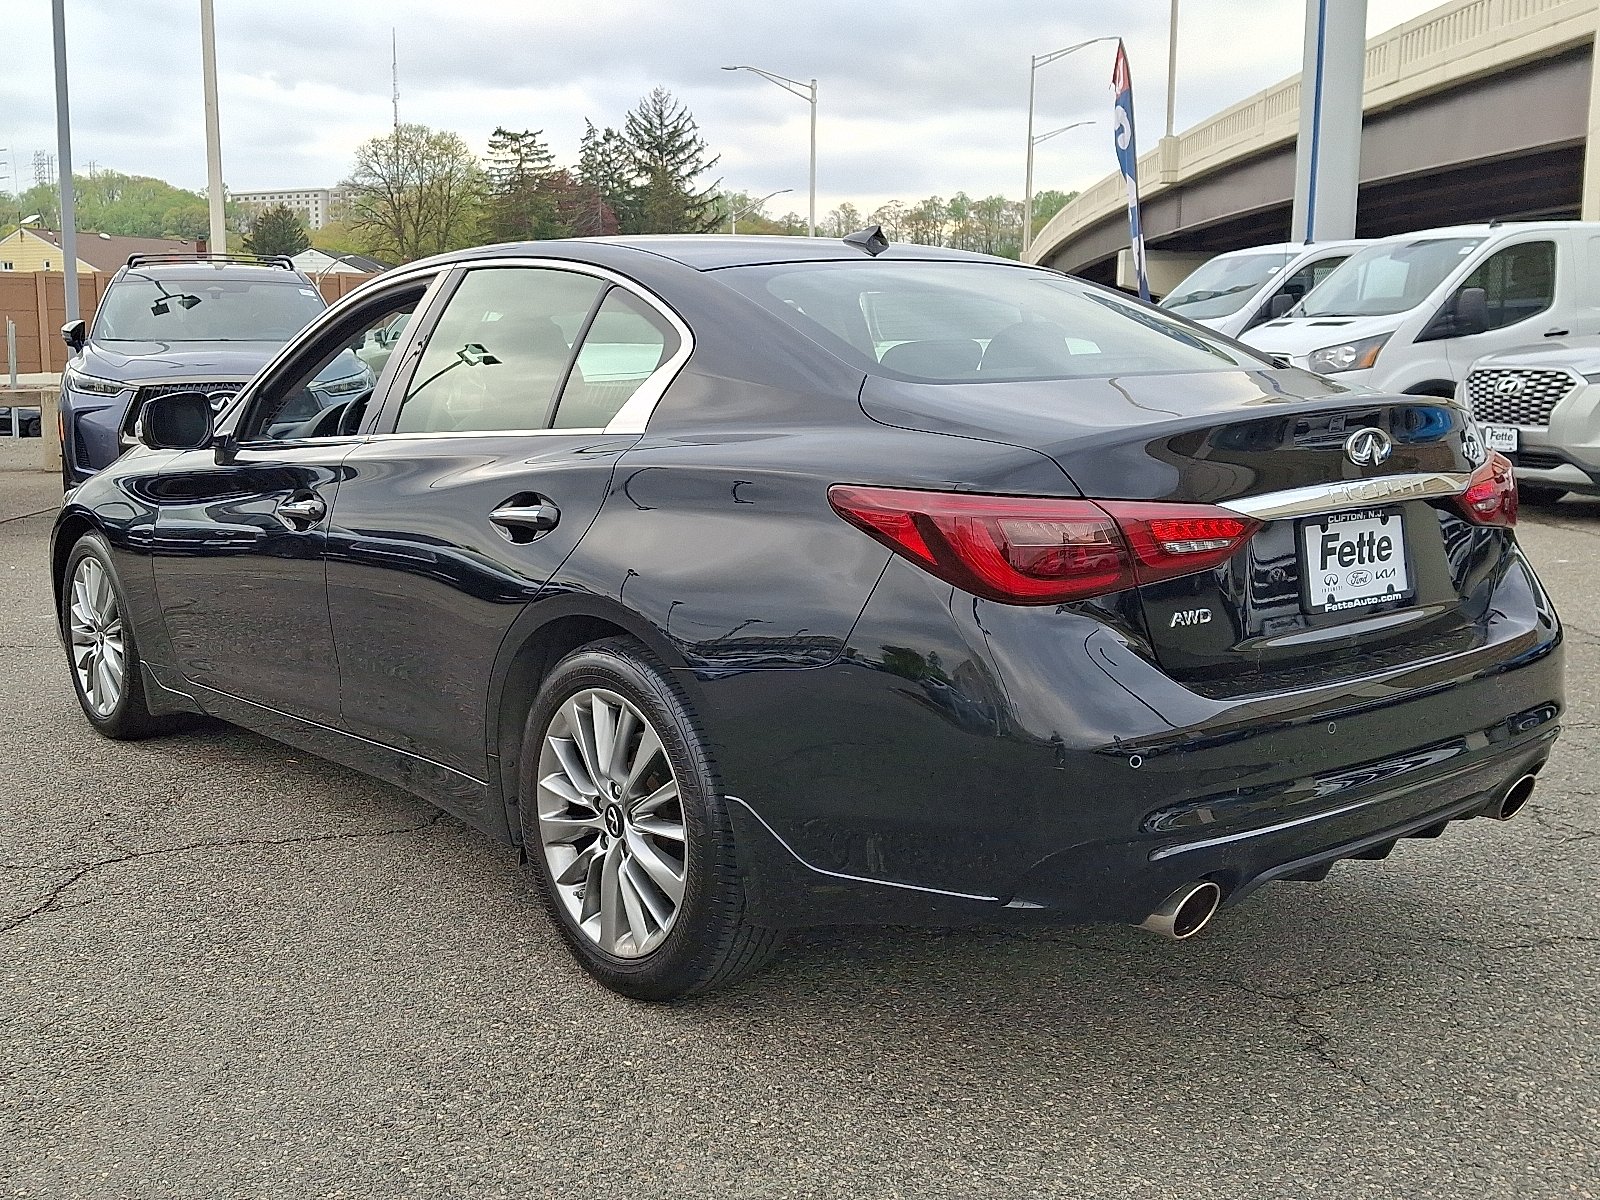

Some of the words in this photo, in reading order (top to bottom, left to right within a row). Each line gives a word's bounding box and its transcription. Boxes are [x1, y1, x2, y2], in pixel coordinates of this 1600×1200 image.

[1490, 430, 1514, 442] Fette
[1328, 511, 1366, 524] CLIFTON,
[1368, 510, 1385, 519] N.J.
[1320, 531, 1393, 571] Fette
[1324, 592, 1402, 613] FetteAuto.com
[1170, 608, 1212, 628] AWD
